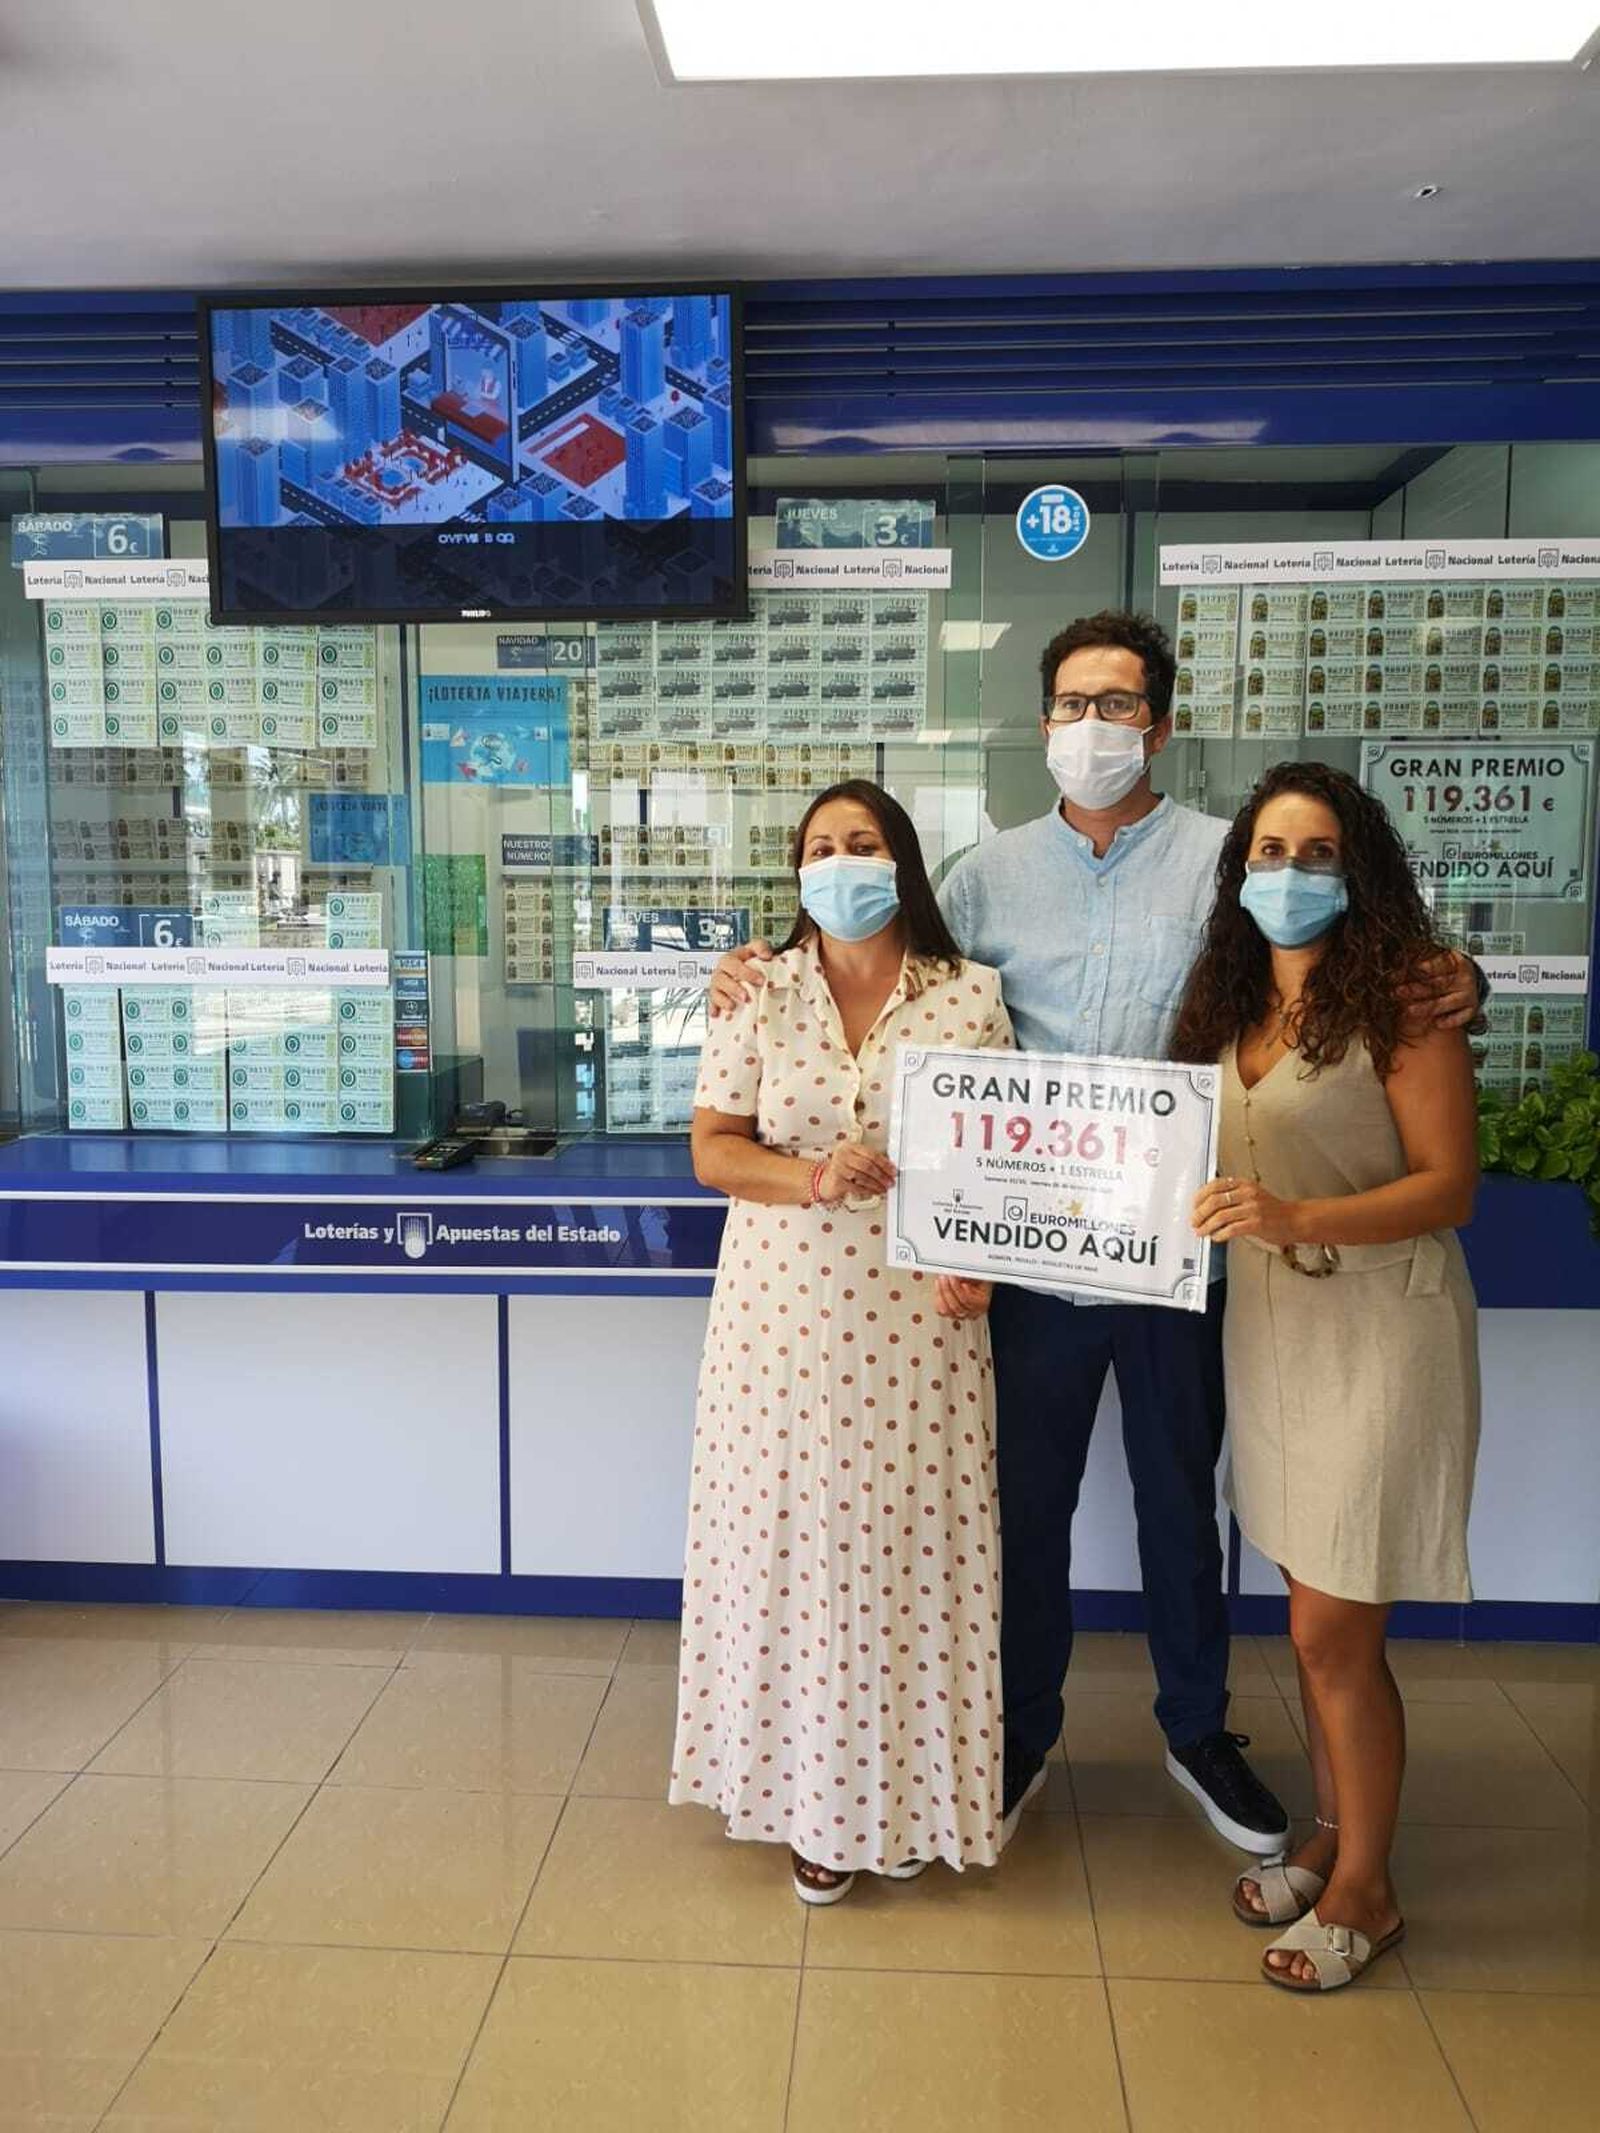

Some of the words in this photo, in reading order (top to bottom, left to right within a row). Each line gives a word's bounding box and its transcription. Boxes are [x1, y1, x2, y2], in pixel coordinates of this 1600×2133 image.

[783, 507, 839, 521] JUEVES
[1026, 505, 1072, 534] +18
[796, 564, 840, 575] Nacional
[904, 564, 949, 575] Nacional
[1224, 558, 1269, 570] Nacional
[1336, 557, 1381, 568] Nacional
[1448, 554, 1493, 566] Nacional
[1561, 553, 1600, 565] Naciona
[84, 575, 127, 586] Nacional
[188, 575, 209, 585] Naci
[553, 641, 582, 661] 20
[1390, 758, 1462, 778] GRAN
[1471, 758, 1565, 778] PREMIO
[1403, 785, 1532, 813] 119.361
[1542, 797, 1555, 811] €
[1408, 861, 1490, 878] ENDIDO
[1497, 856, 1555, 879] AQUÍ
[64, 912, 120, 928] SÁBADO
[106, 961, 147, 972] Nacional
[207, 962, 249, 972] Nacional
[308, 963, 349, 973] Nacional
[596, 965, 638, 976] Nacional
[1541, 970, 1586, 980] Nacional
[931, 1072, 1030, 1104] GRAN
[1044, 1079, 1177, 1117] PREMIO
[951, 1110, 1127, 1166] 119.361
[1143, 1147, 1161, 1168] €
[976, 1156, 983, 1167] 5
[985, 1156, 1047, 1173] NÚMEROS
[1069, 1164, 1123, 1181] ESTRELLA
[304, 1222, 378, 1240] Loterías
[383, 1226, 395, 1243] y
[436, 1224, 520, 1243] Apuestas
[525, 1224, 553, 1242] del
[557, 1225, 621, 1243] Estado
[1029, 1212, 1137, 1237] EUROMILLONES
[933, 1215, 1068, 1253] VENDIDO
[1078, 1234, 1160, 1267] AQUÍ
